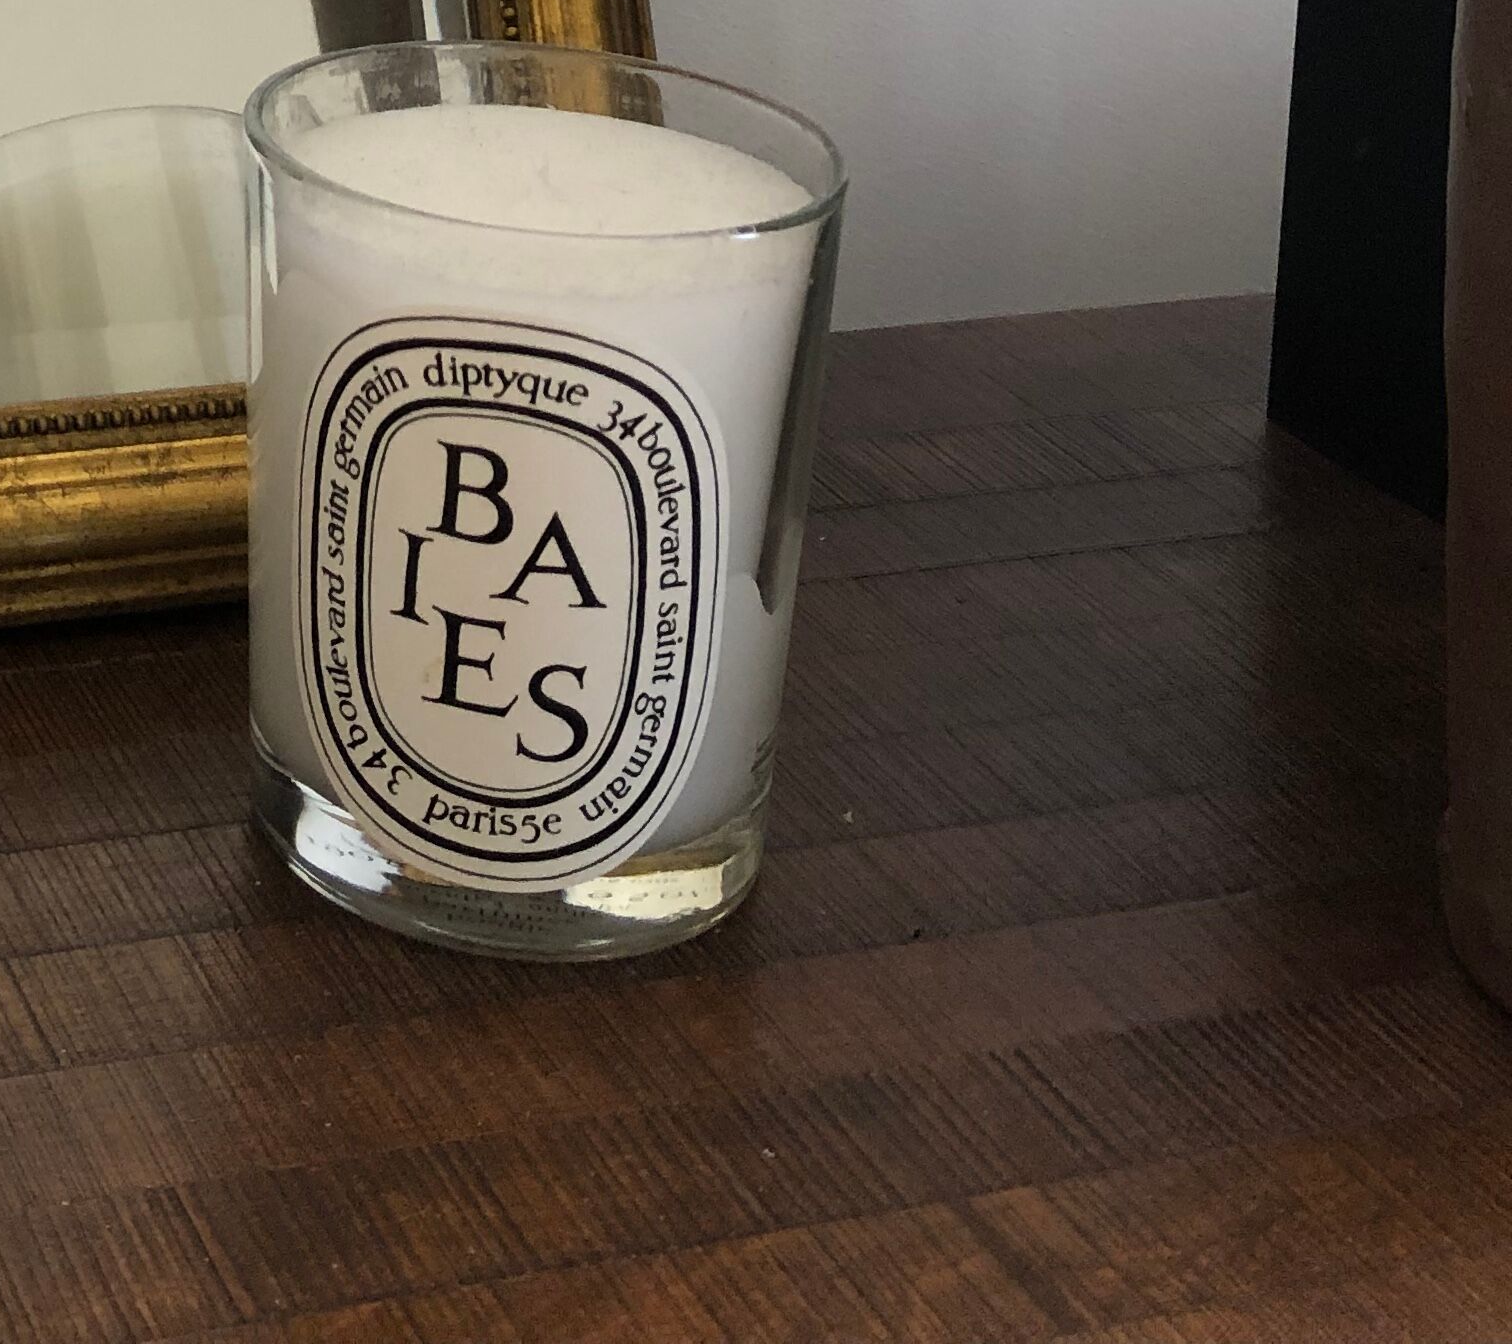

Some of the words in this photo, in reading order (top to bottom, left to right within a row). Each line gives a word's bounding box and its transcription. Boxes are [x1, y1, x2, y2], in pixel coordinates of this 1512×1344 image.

[422, 350, 589, 407] diptyque
[333, 365, 410, 481] germain
[323, 479, 350, 566] saint
[651, 602, 684, 685] saint
[578, 692, 667, 822] germain
